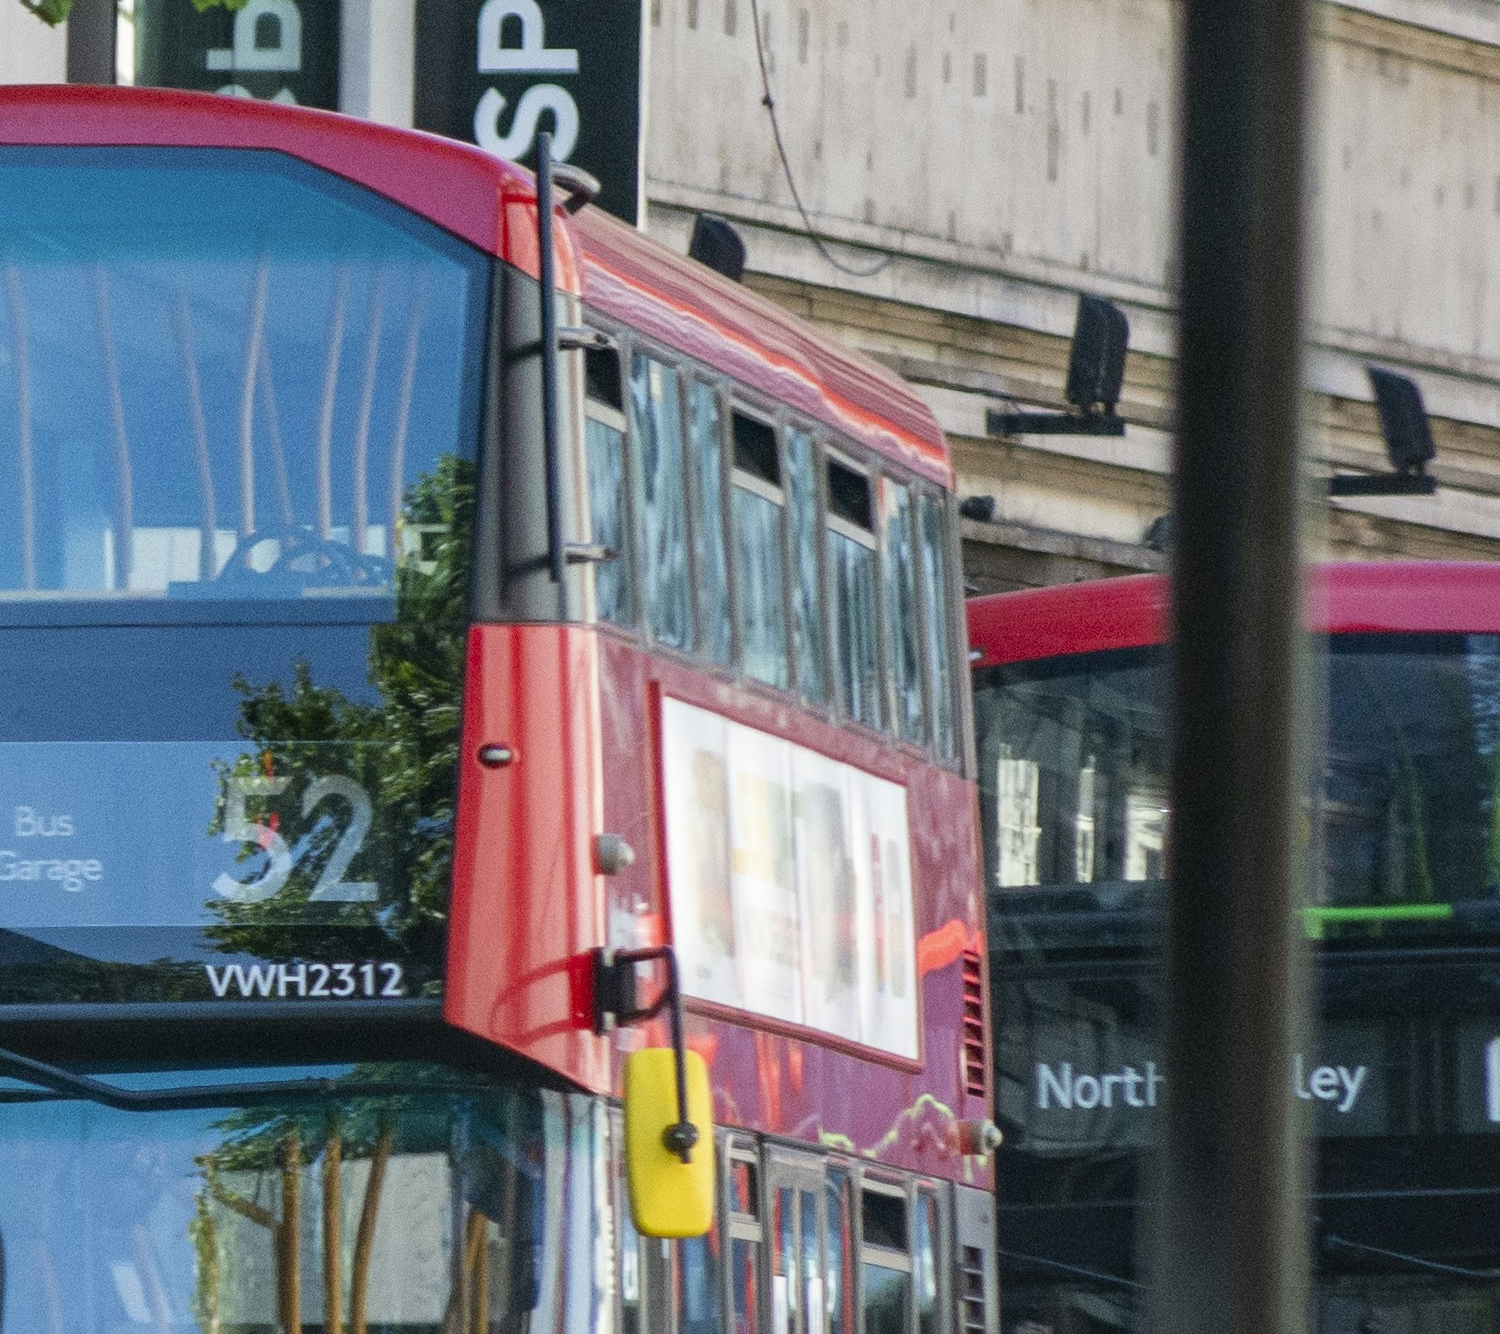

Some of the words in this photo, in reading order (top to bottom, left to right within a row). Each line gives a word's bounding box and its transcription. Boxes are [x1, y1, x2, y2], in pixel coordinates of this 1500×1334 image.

[14, 805, 75, 838] Bus
[210, 776, 381, 905] 52
[205, 961, 404, 999] VWH2312
